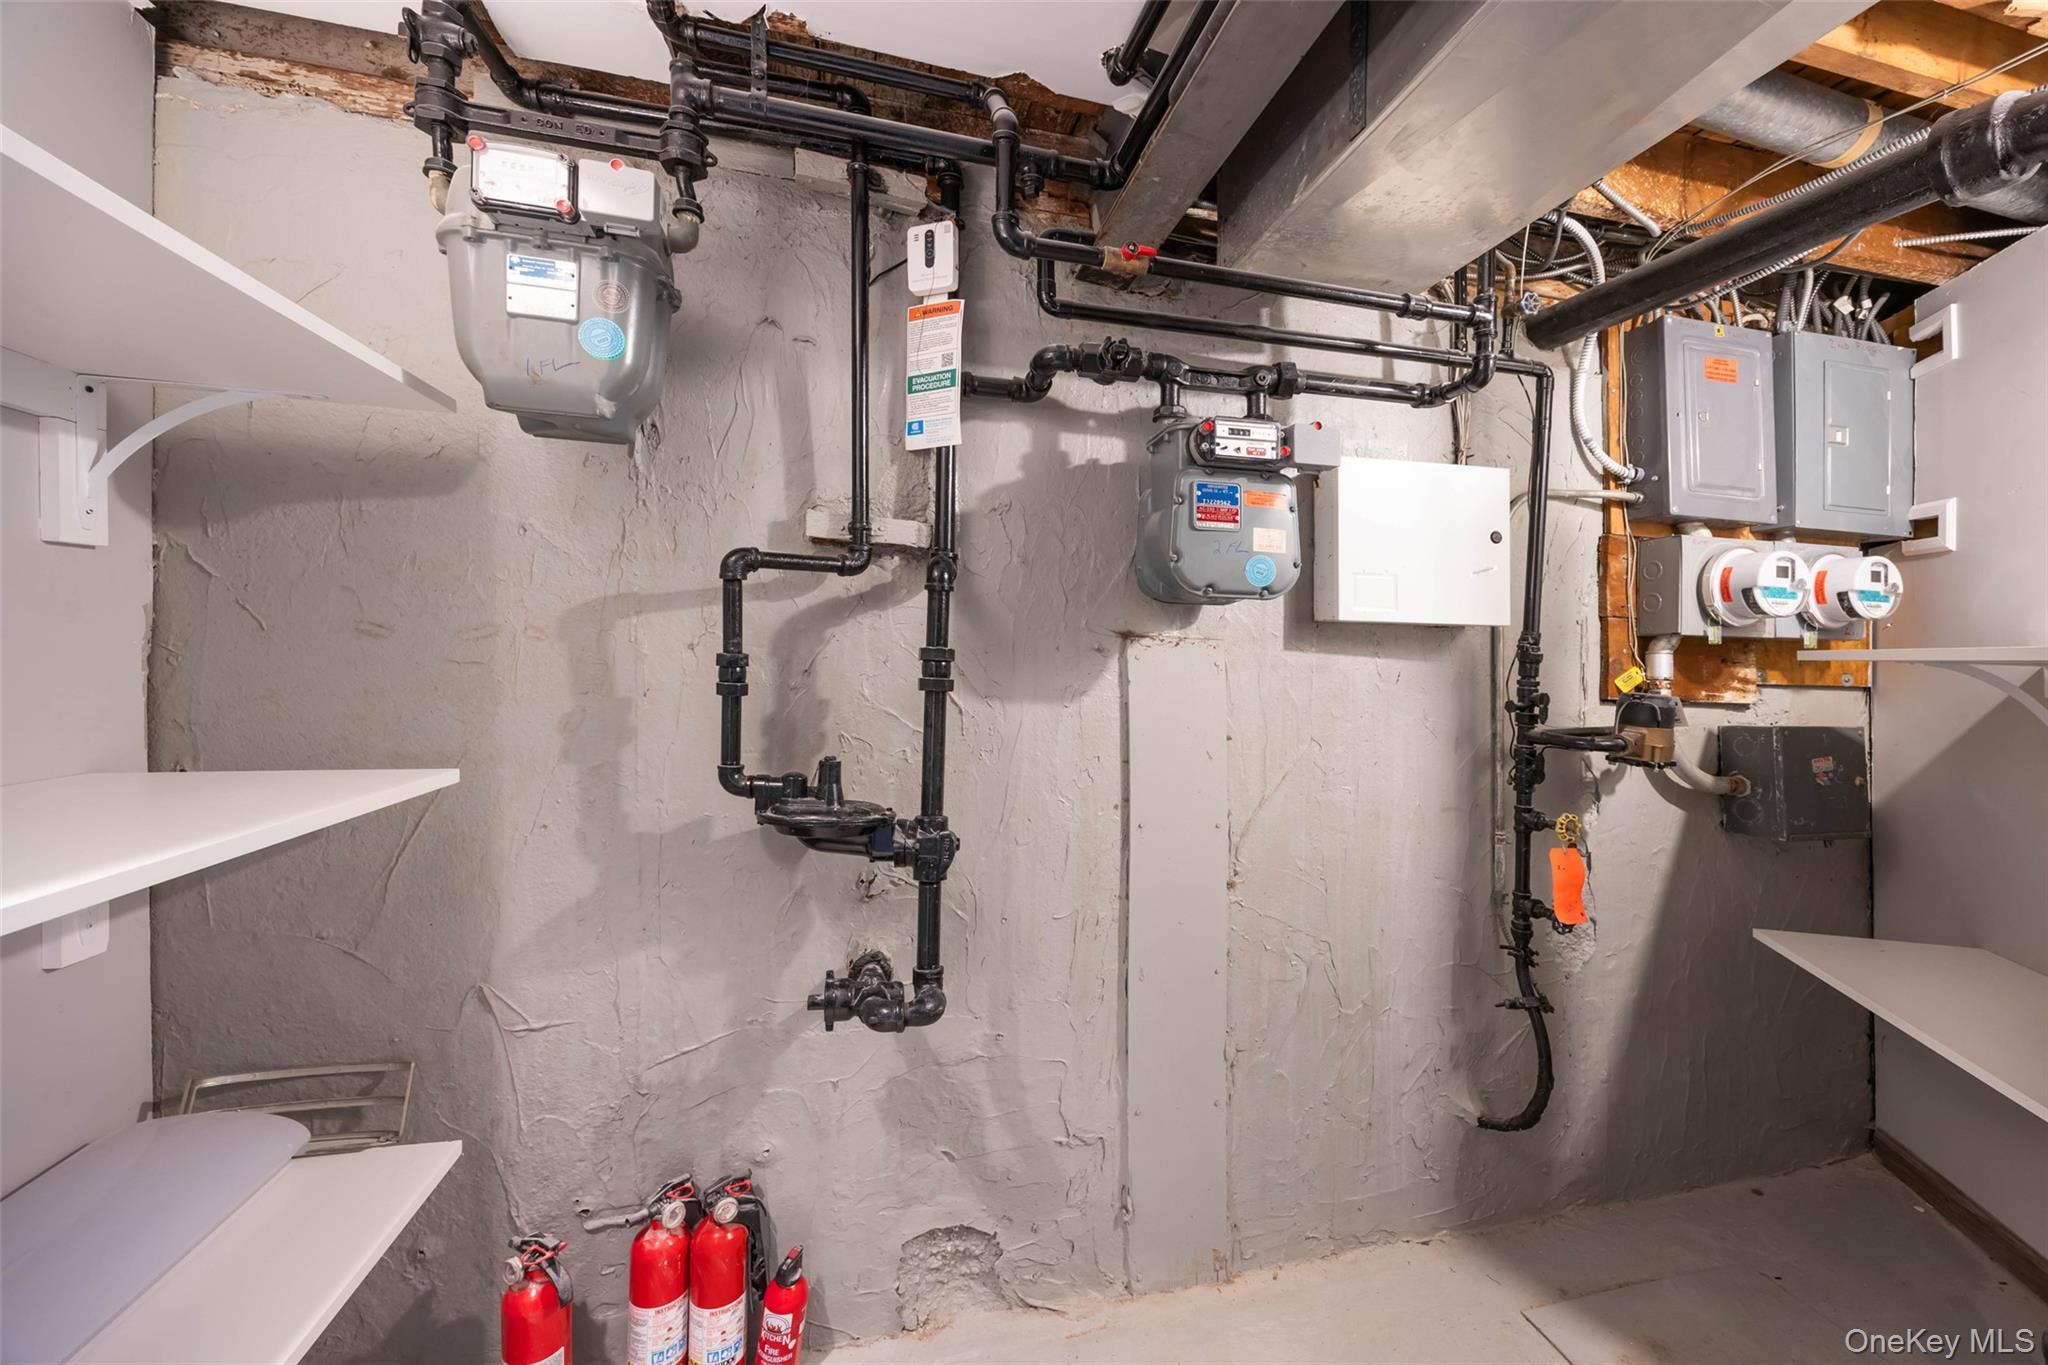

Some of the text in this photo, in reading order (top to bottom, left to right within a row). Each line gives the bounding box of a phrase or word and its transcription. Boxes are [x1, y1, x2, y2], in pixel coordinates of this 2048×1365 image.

[922, 305, 953, 315] WARNING
[912, 372, 952, 385] EVACUATION
[912, 379, 952, 392] PROCEDURE
[761, 1327, 791, 1345] KITCHEN
[764, 1344, 781, 1356] FIRE
